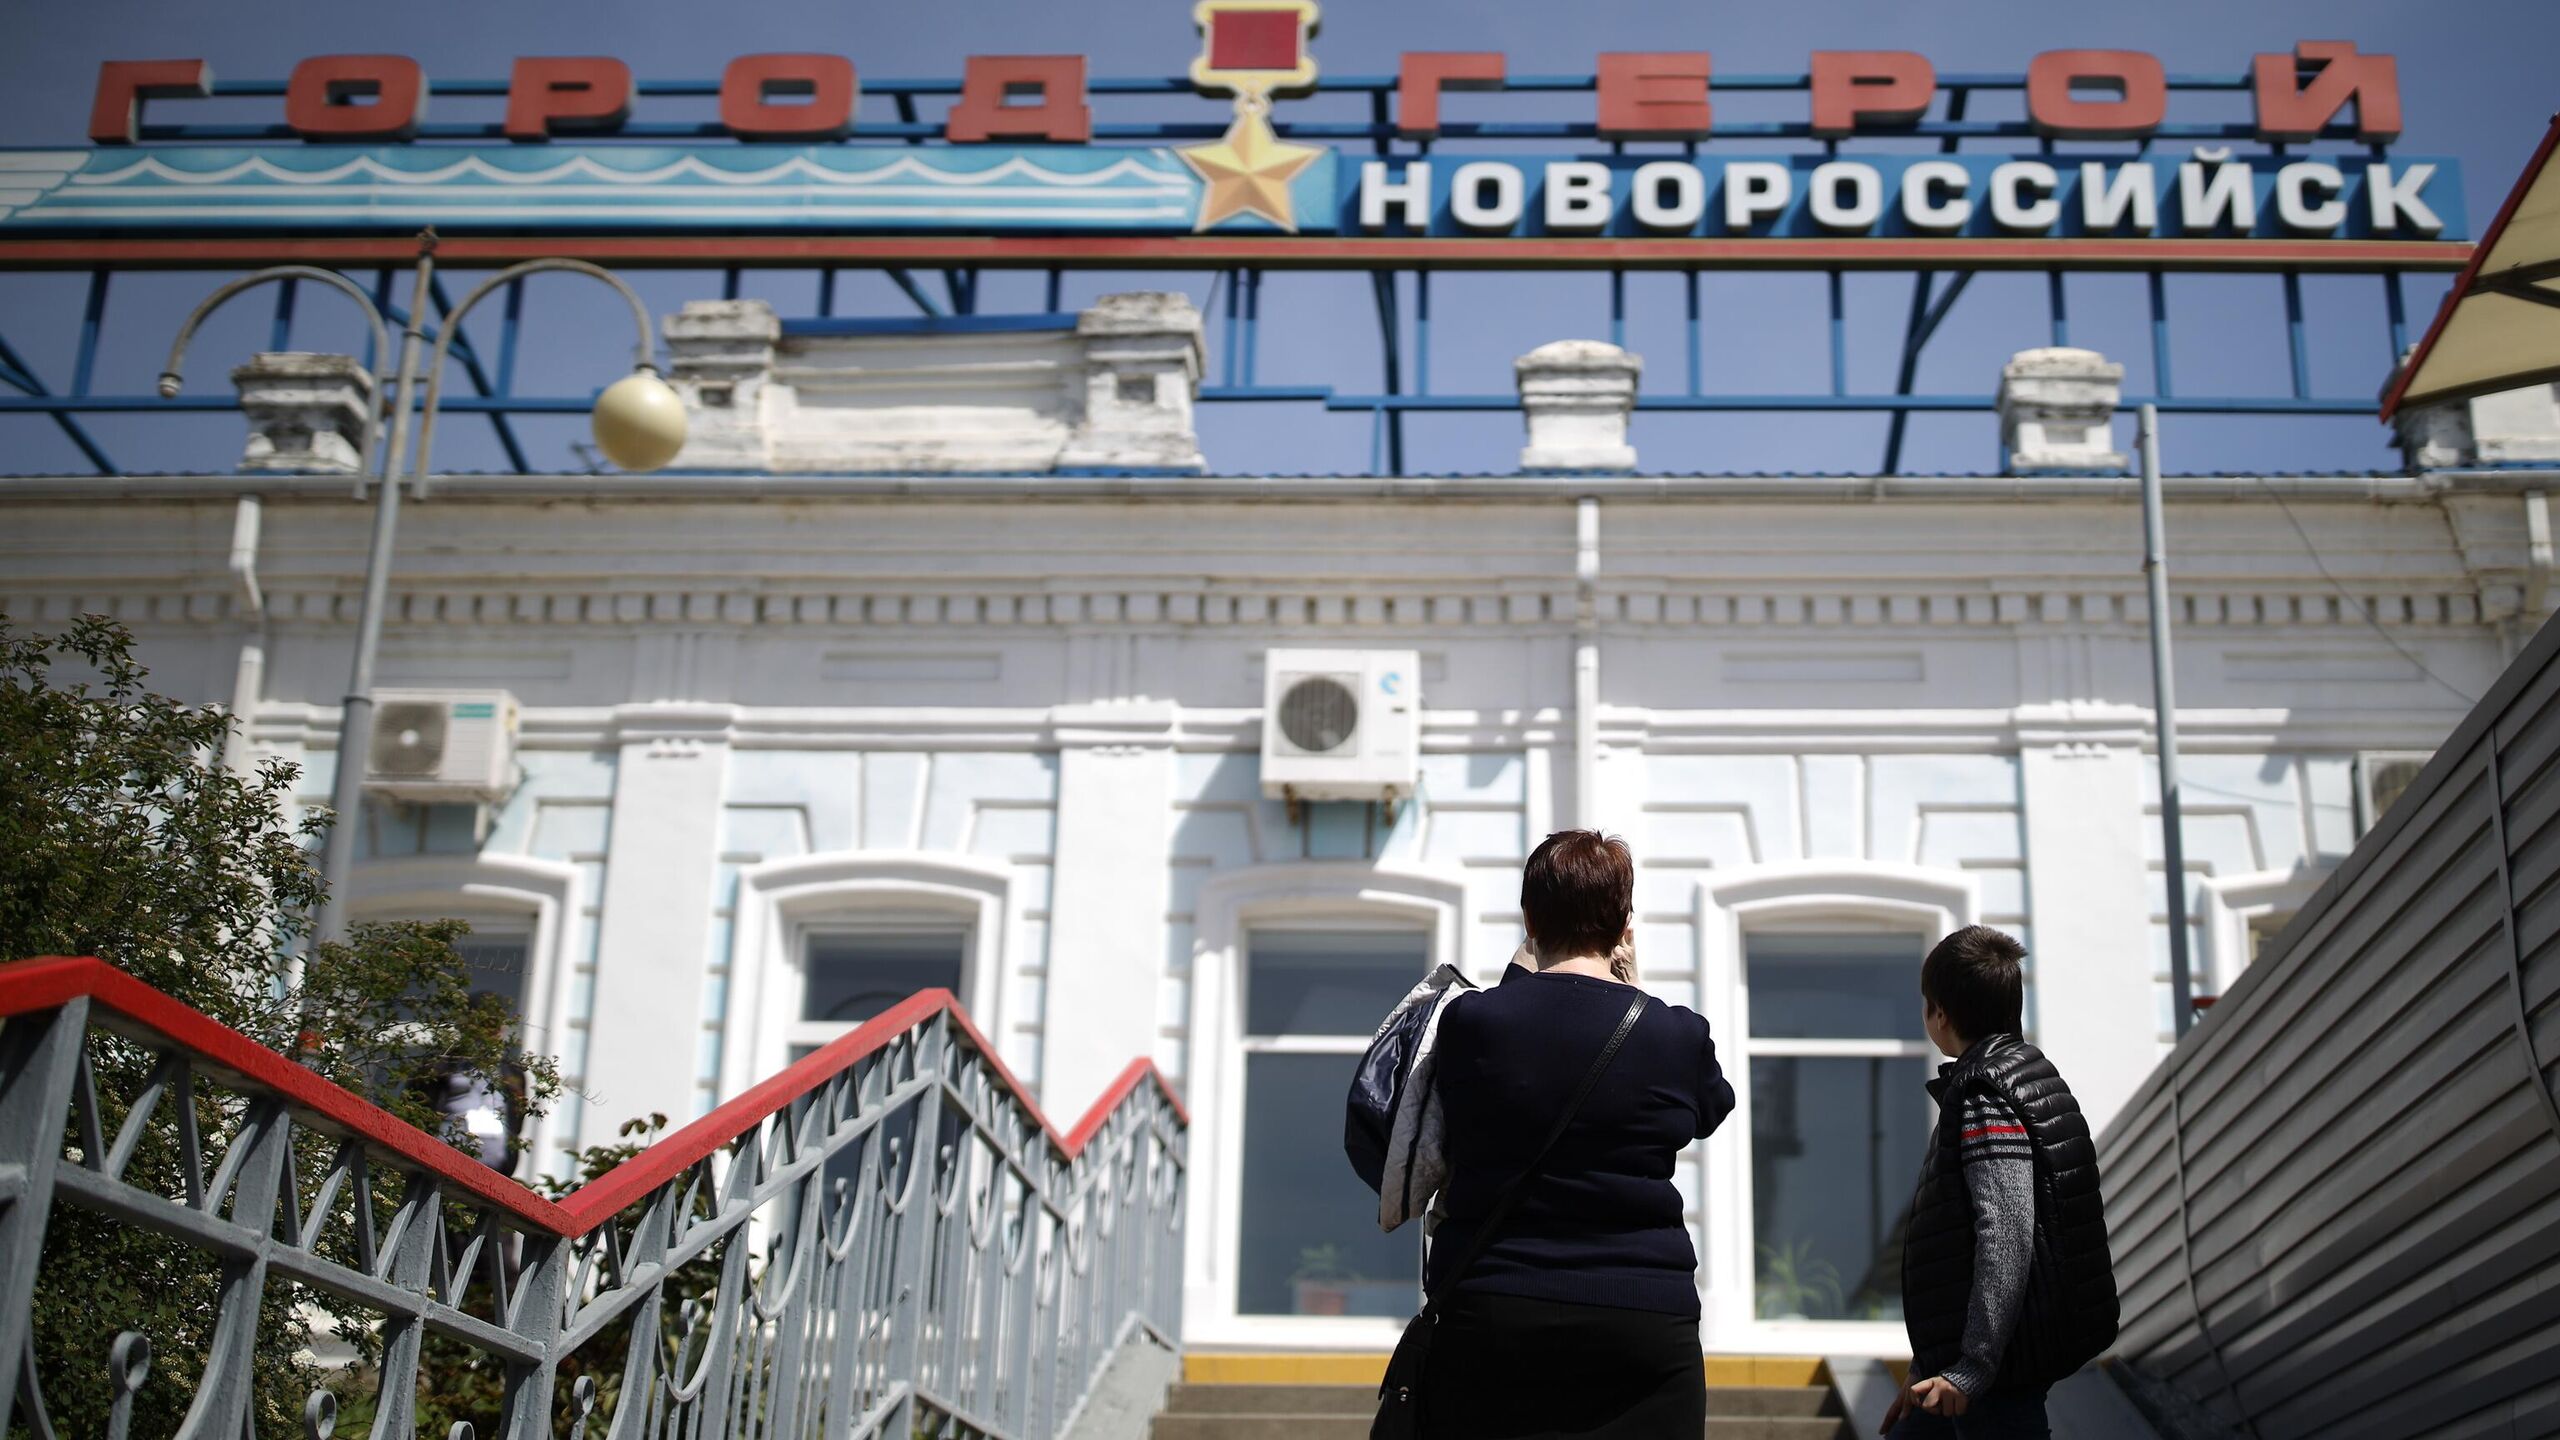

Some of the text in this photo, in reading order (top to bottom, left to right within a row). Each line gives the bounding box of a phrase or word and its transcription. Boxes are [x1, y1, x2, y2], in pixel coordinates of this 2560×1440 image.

[88, 40, 2402, 144] ГОРОД ГЕРОЙ
[1359, 147, 2444, 237] НОВОРОССИЙСК
